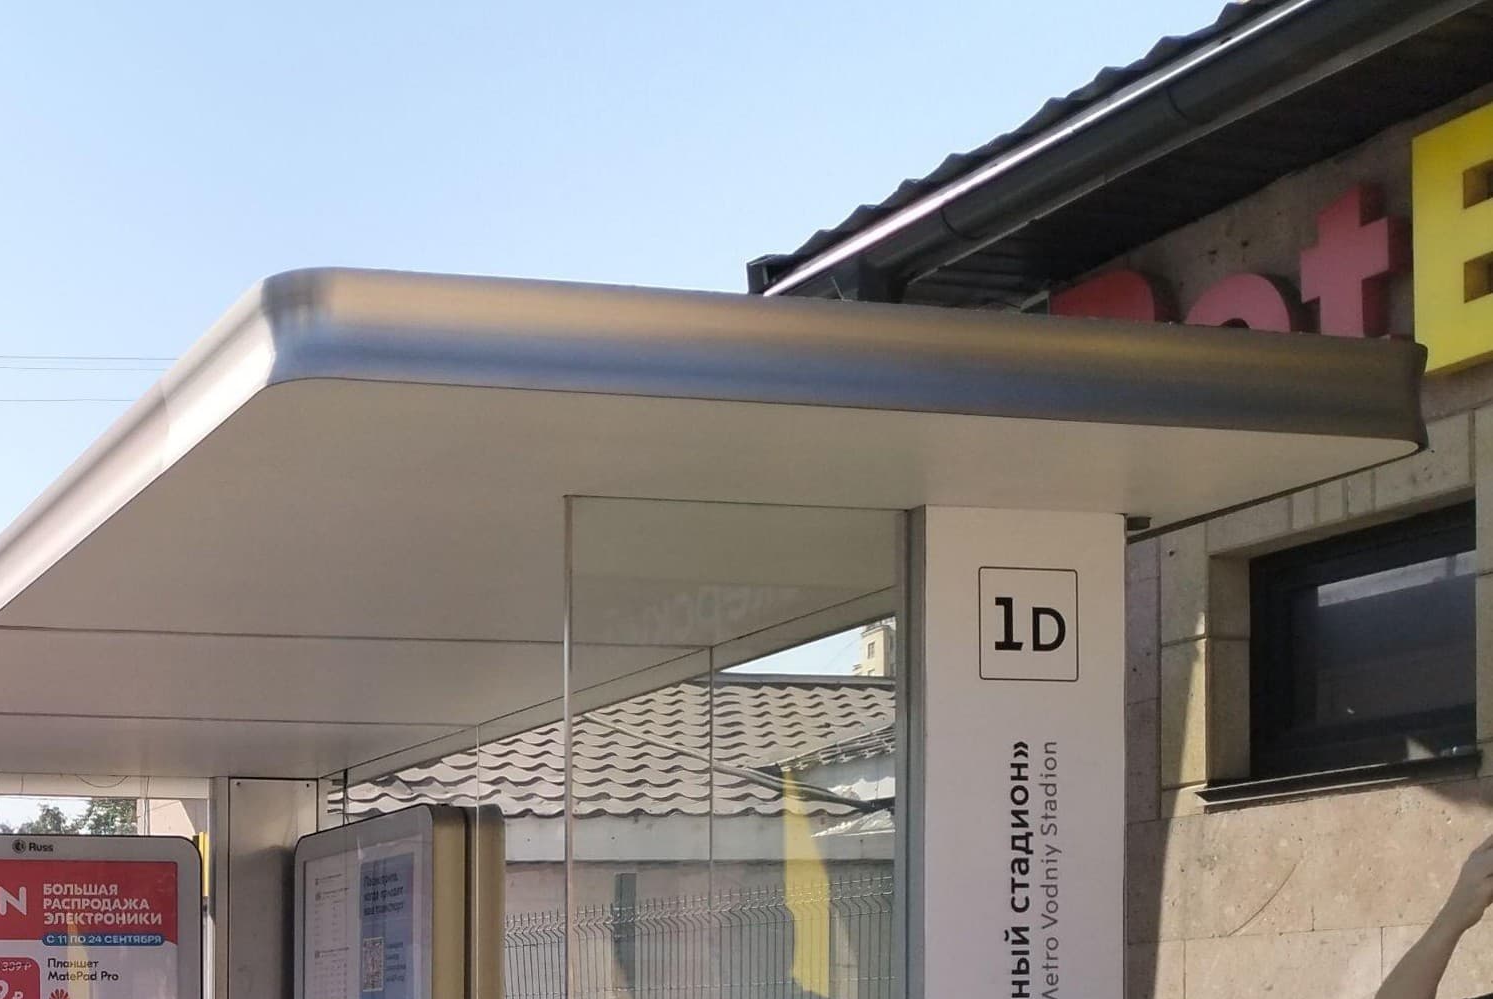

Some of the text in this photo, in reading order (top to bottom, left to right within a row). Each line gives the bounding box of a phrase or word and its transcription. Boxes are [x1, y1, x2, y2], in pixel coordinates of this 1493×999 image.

[994, 596, 1066, 652] 1D
[1040, 741, 1059, 837] Stadion
[1007, 741, 1035, 913] стадион»
[28, 842, 54, 852] Russ
[43, 883, 118, 896] БОЛЬШАЯ
[1041, 843, 1063, 929] Vodniy
[43, 898, 150, 911] РАСПРОДАЖА
[43, 912, 162, 925] ЭЛЕКТРОНИКИ
[58, 935, 67, 944] 11
[70, 934, 86, 944] ПО
[88, 934, 102, 944] 24
[104, 934, 162, 944] СЕНТЯБРЯ
[47, 958, 99, 968] Планшет
[48, 971, 119, 981] MatePad Pro
